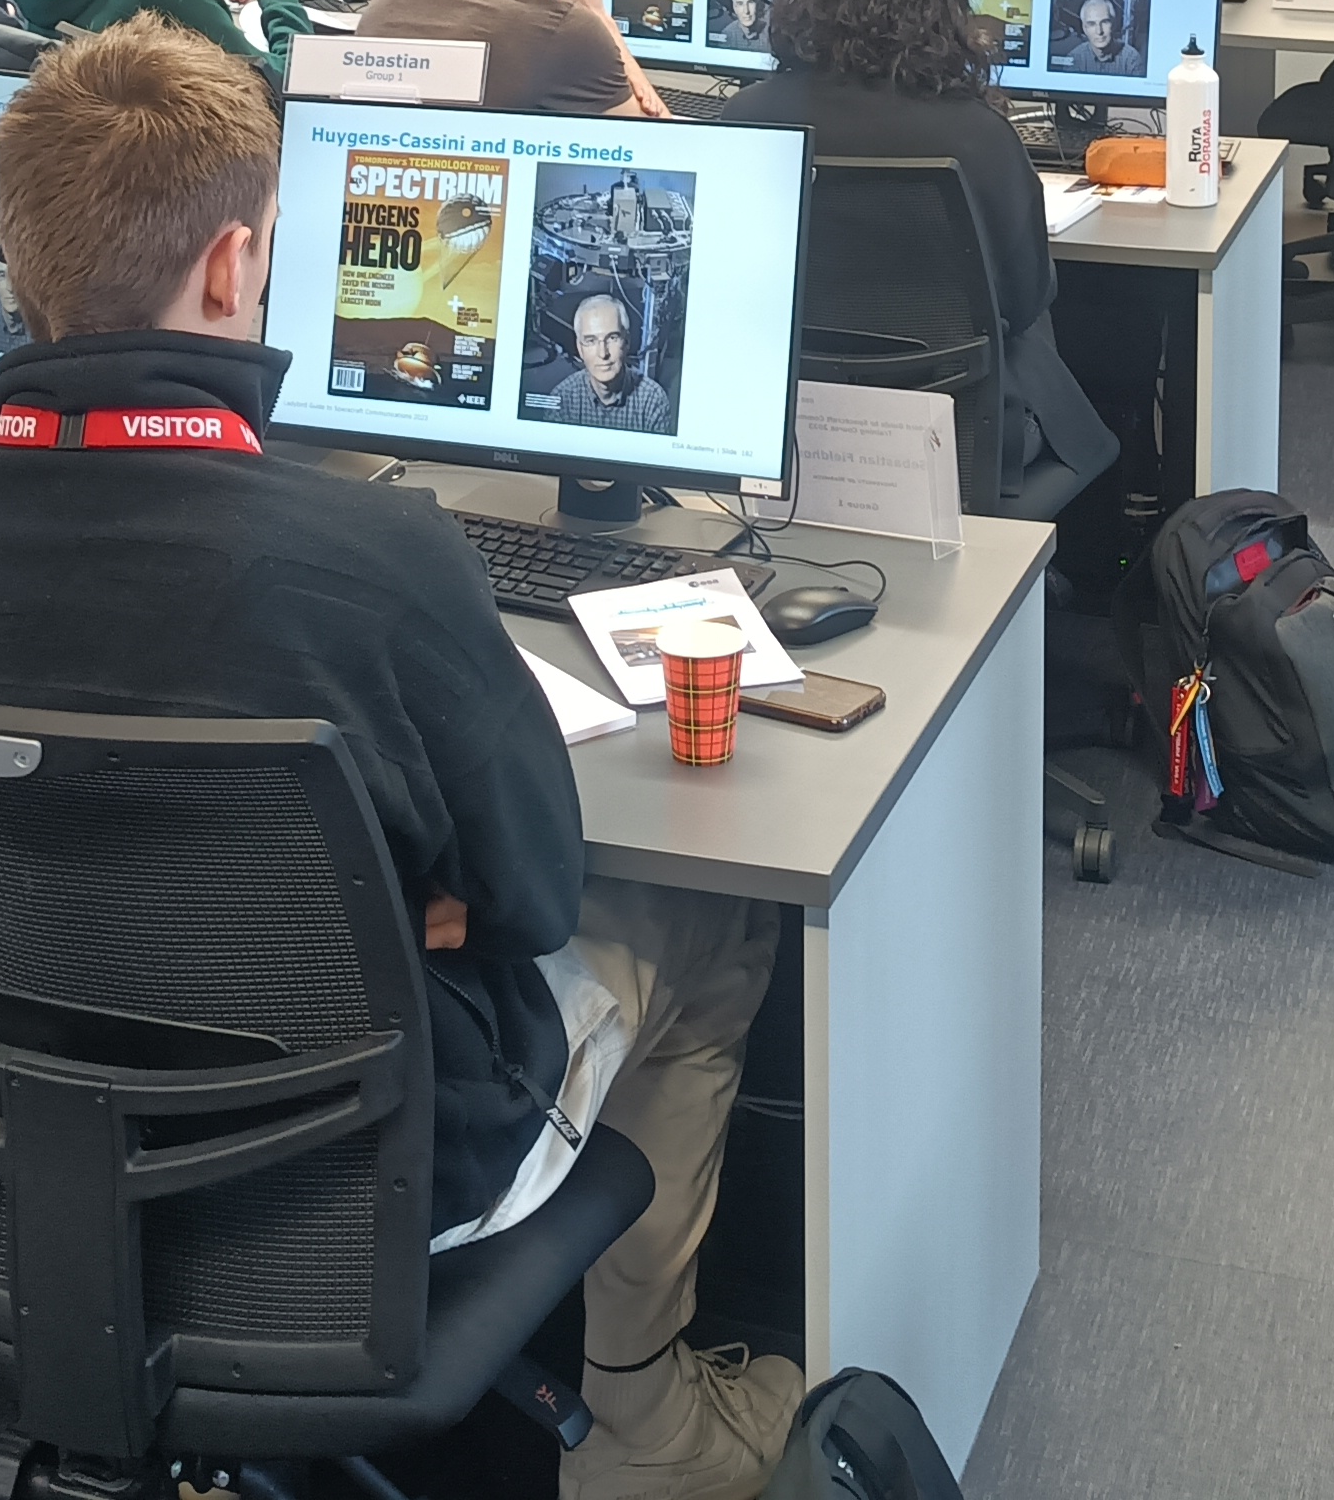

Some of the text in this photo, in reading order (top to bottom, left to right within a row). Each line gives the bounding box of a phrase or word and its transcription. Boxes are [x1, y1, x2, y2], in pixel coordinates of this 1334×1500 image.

[342, 50, 431, 70] Sebastian
[366, 70, 395, 83] Group
[311, 126, 634, 163] Huygens-Cassini and Boris Smeds
[1188, 126, 1202, 163] RUTA
[1199, 108, 1212, 175] DORAMAS
[354, 155, 501, 172] TOMORROW'S TECHNOLOGY TODAY
[349, 164, 504, 206] SPECTRUM
[342, 201, 420, 228] HUYGENS
[339, 223, 423, 271] HERO
[466, 394, 486, 406] IEEE
[122, 415, 222, 439] VISITOR
[493, 451, 520, 464] DELL
[671, 441, 685, 450] ESA
[686, 443, 715, 455] Academy
[721, 447, 737, 456] Slide
[546, 1106, 580, 1141] PALACE
